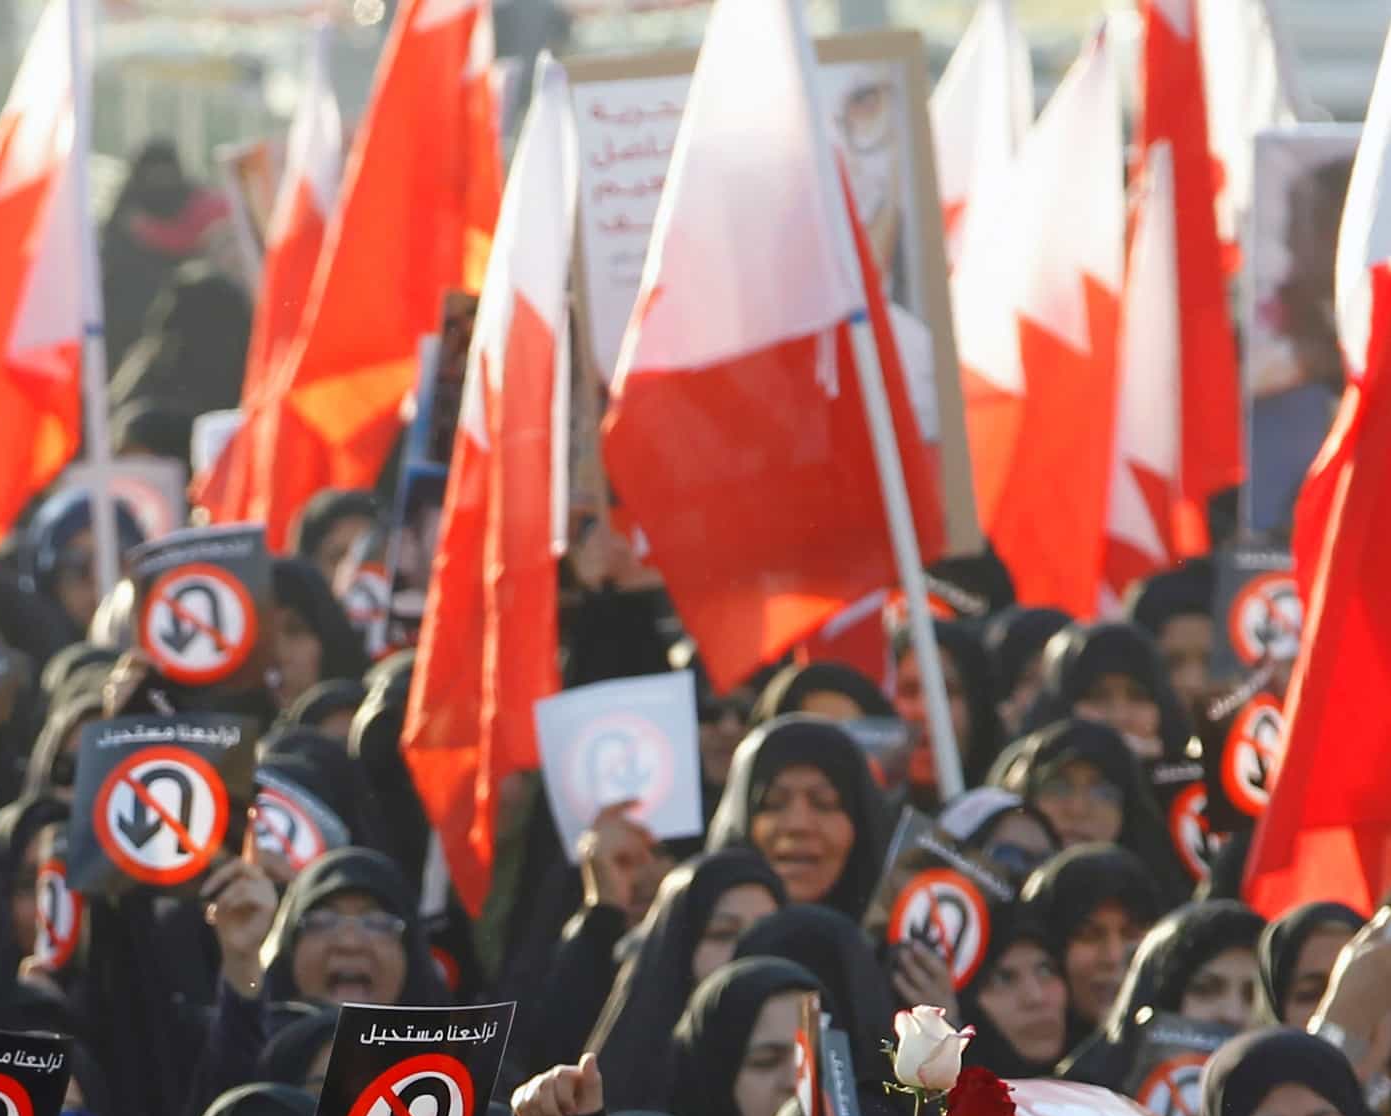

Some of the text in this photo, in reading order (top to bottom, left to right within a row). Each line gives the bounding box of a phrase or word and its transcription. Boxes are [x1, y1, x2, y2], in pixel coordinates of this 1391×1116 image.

[360, 1021, 499, 1045] تراجعنا مستحيل
[13, 1049, 65, 1073] تراجعنا
